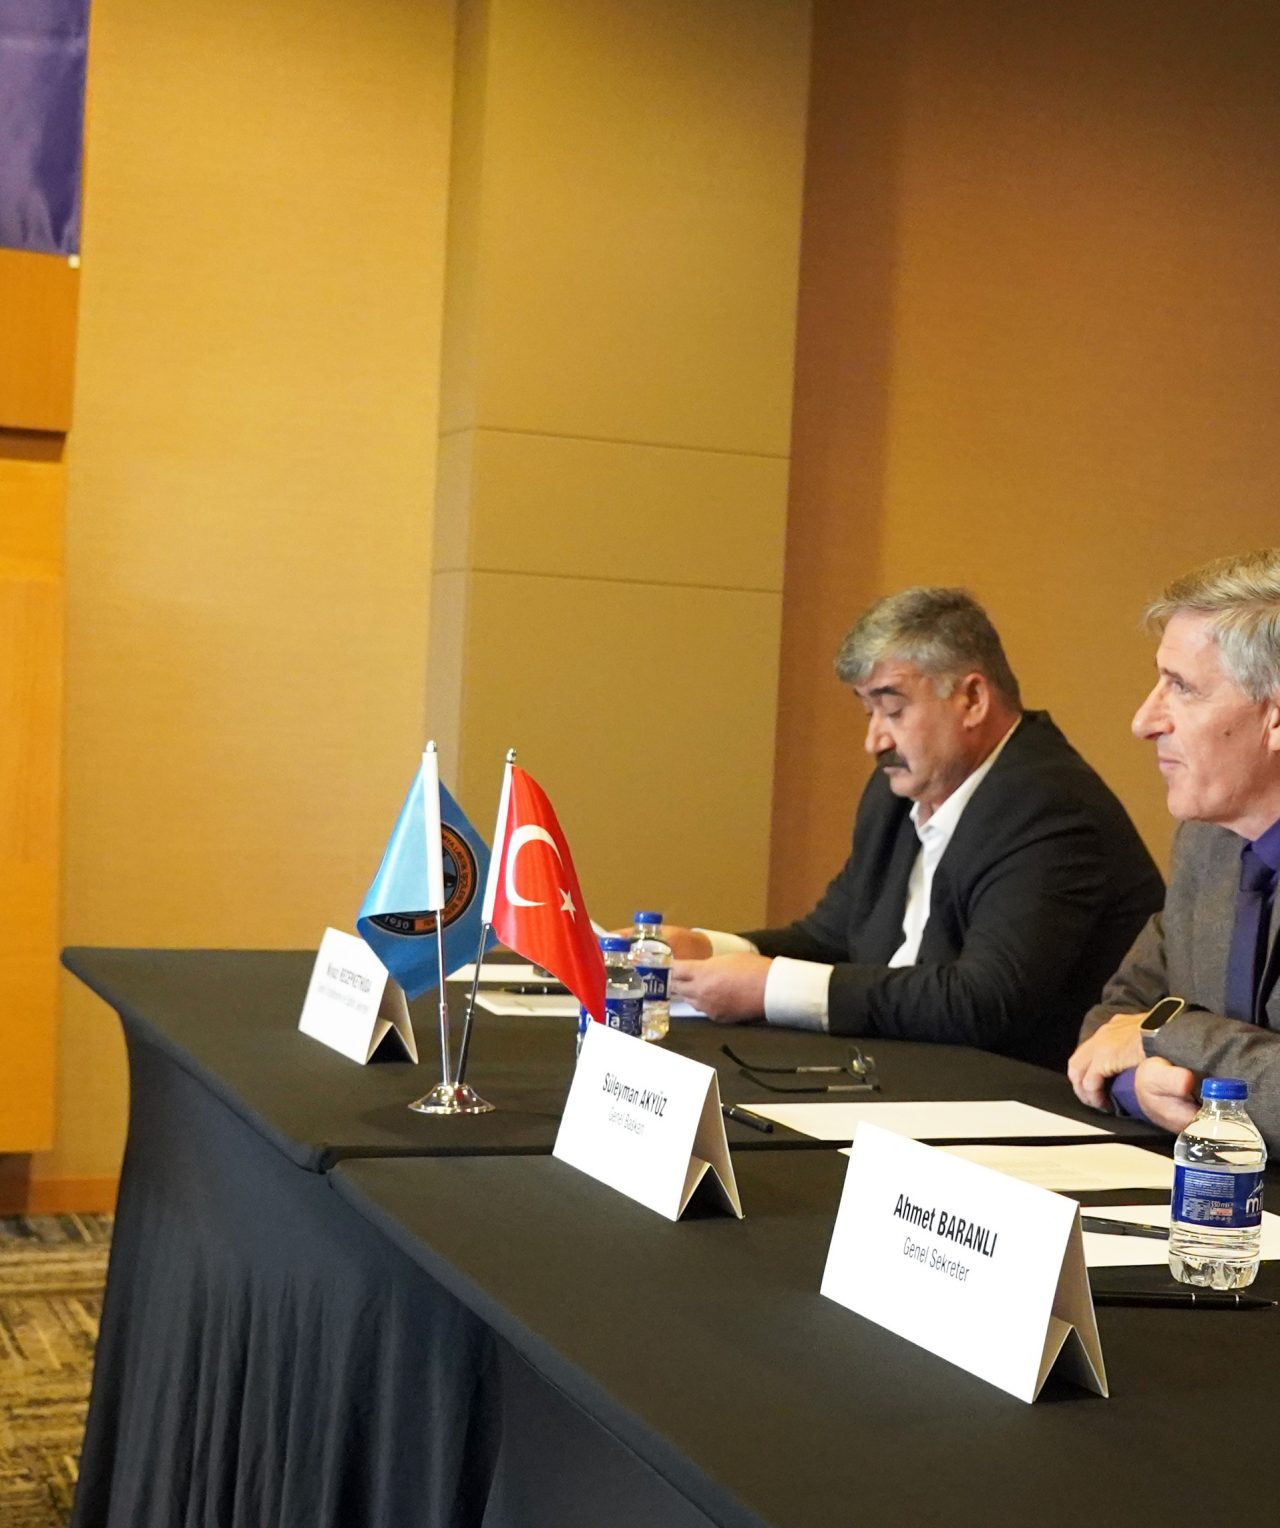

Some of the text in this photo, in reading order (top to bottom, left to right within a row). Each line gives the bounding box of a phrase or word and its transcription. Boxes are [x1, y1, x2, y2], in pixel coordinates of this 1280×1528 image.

[384, 915, 409, 930] 1950
[602, 1072, 668, 1118] Süleyman AKYÜZ
[608, 1108, 624, 1129] Genel
[893, 1193, 998, 1258] Ahmet BARANLI
[903, 1236, 970, 1283] Genel Sekreter
